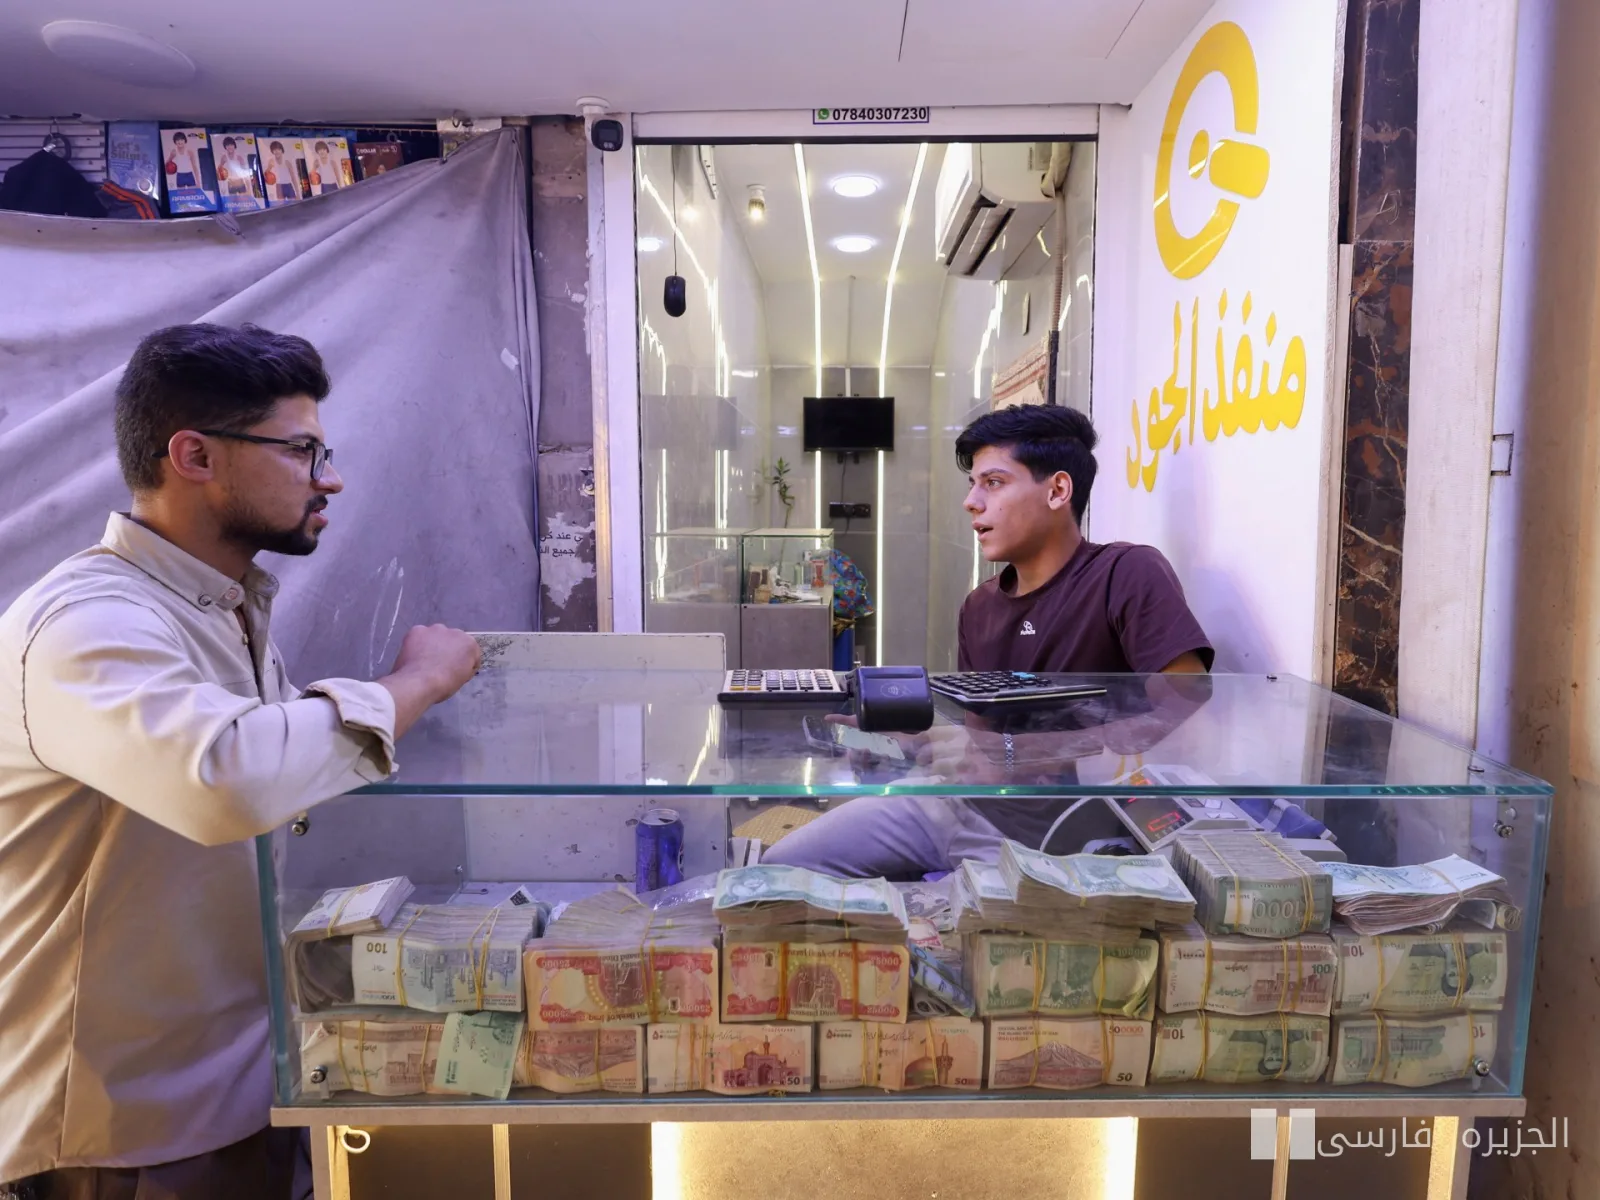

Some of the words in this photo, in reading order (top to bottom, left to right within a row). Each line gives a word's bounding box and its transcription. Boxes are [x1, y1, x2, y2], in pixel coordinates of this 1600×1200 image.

[832, 107, 927, 120] 07840307230
[1202, 288, 1307, 442] منفذ
[556, 532, 572, 540] عند
[366, 942, 388, 954] 100
[1350, 945, 1365, 957] 10
[1171, 1028, 1185, 1040] 10
[787, 1077, 801, 1085] 50
[1115, 1072, 1133, 1082] 50
